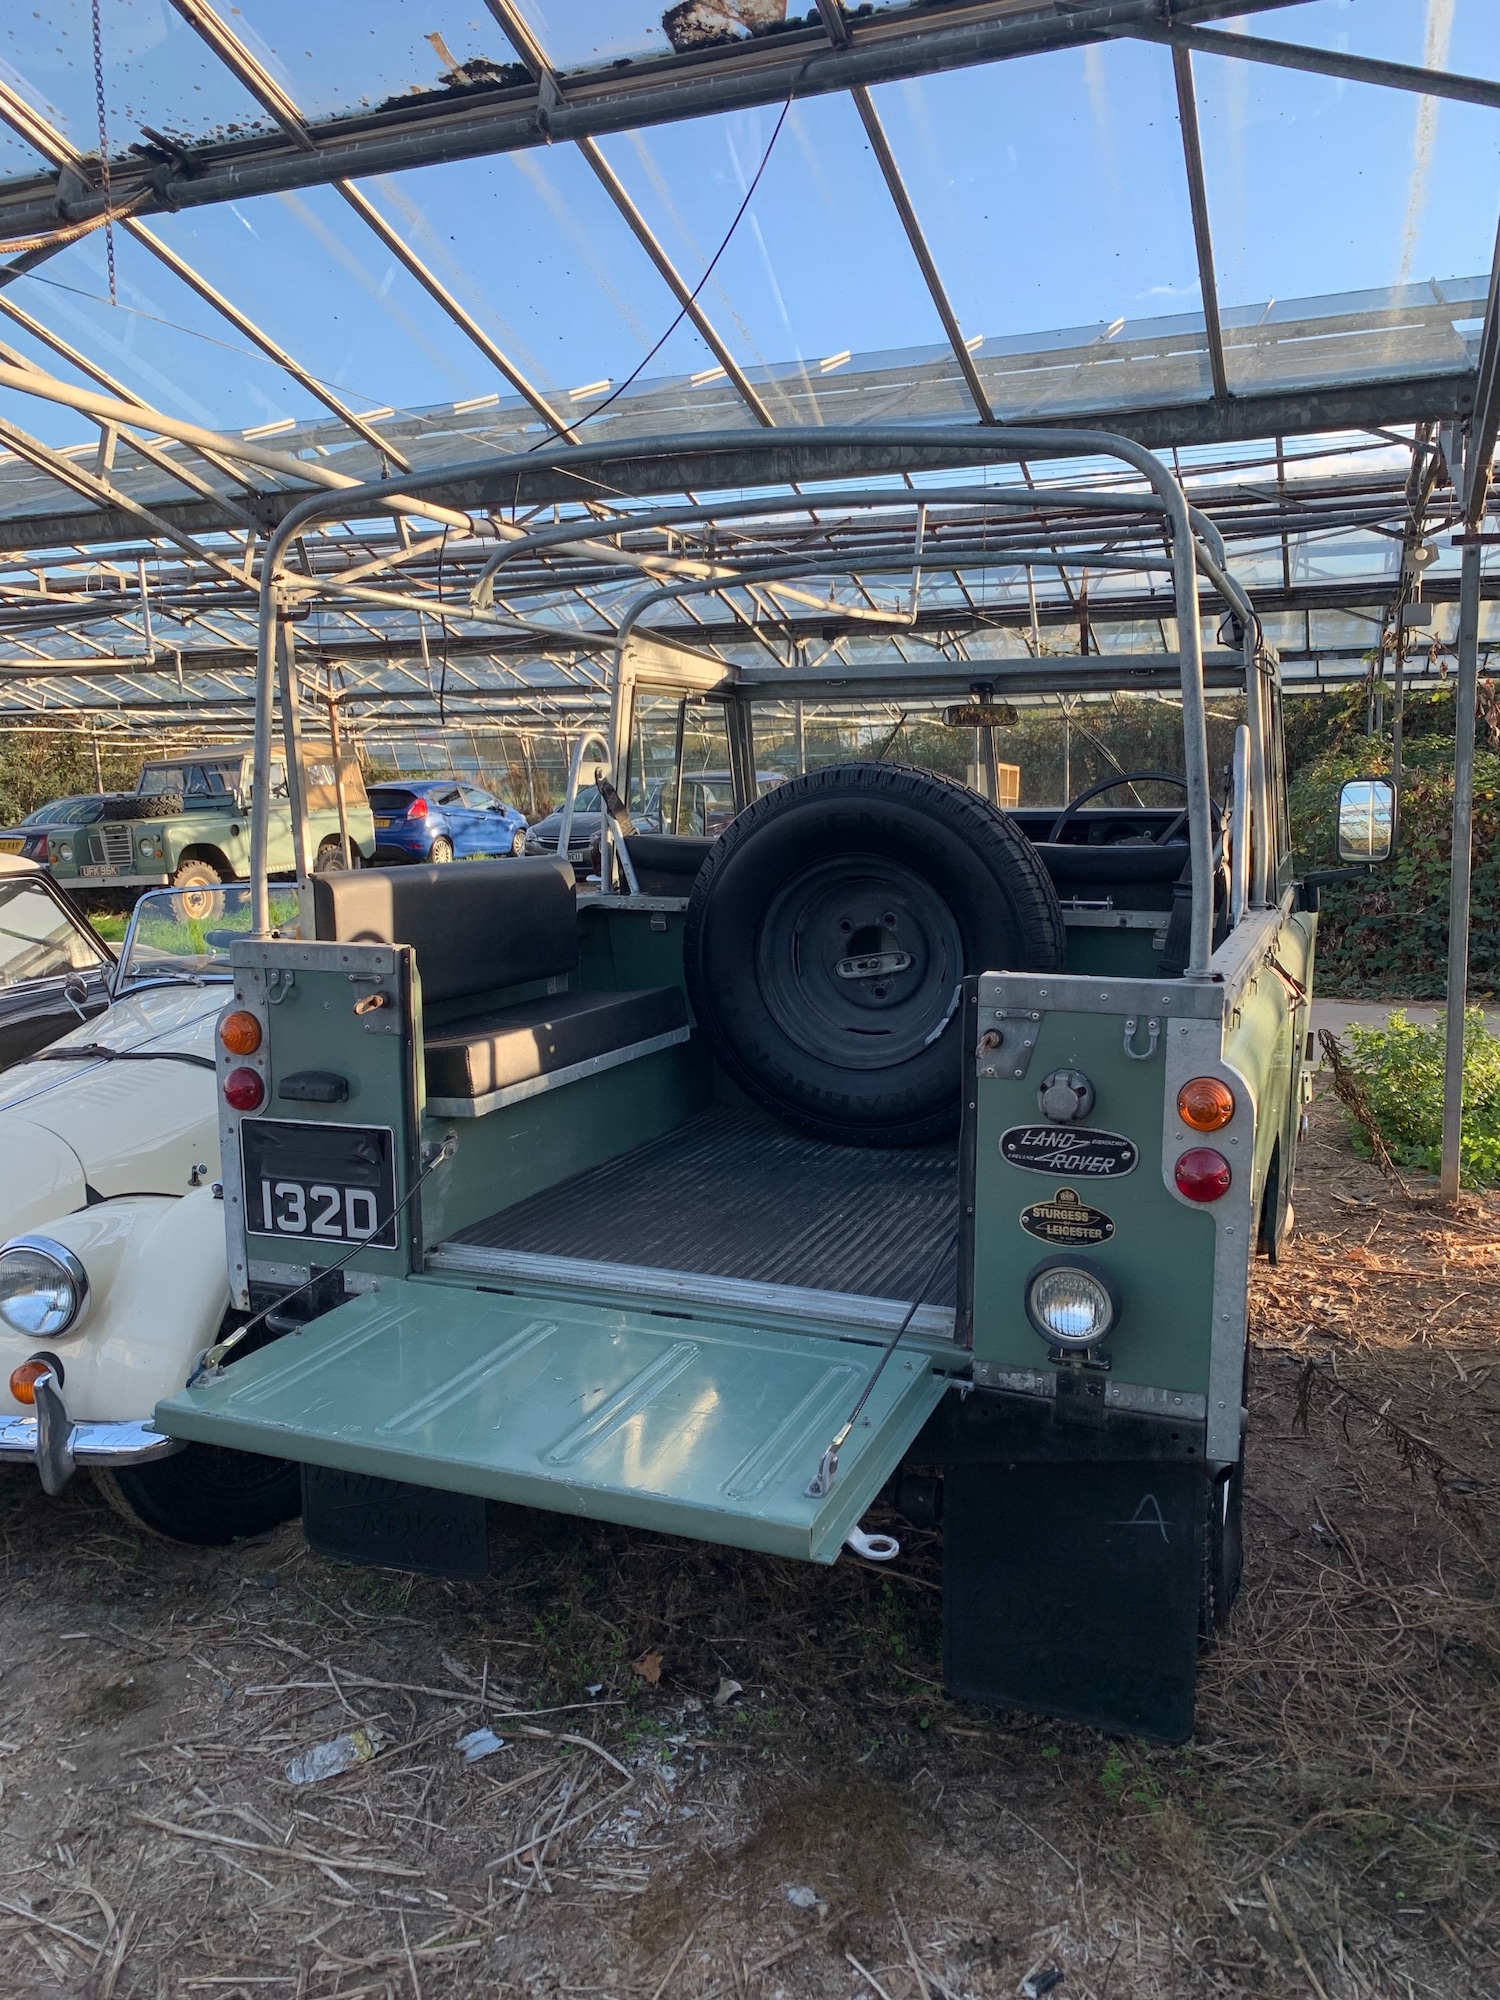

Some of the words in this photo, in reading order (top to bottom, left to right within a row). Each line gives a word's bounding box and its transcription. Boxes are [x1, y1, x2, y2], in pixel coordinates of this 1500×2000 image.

[1020, 1129, 1076, 1149] LAND
[1051, 1154, 1116, 1174] ROVER
[261, 1180, 378, 1239] 132D
[1032, 1207, 1089, 1222] STURGESS
[1046, 1224, 1103, 1239] LEICESTER
